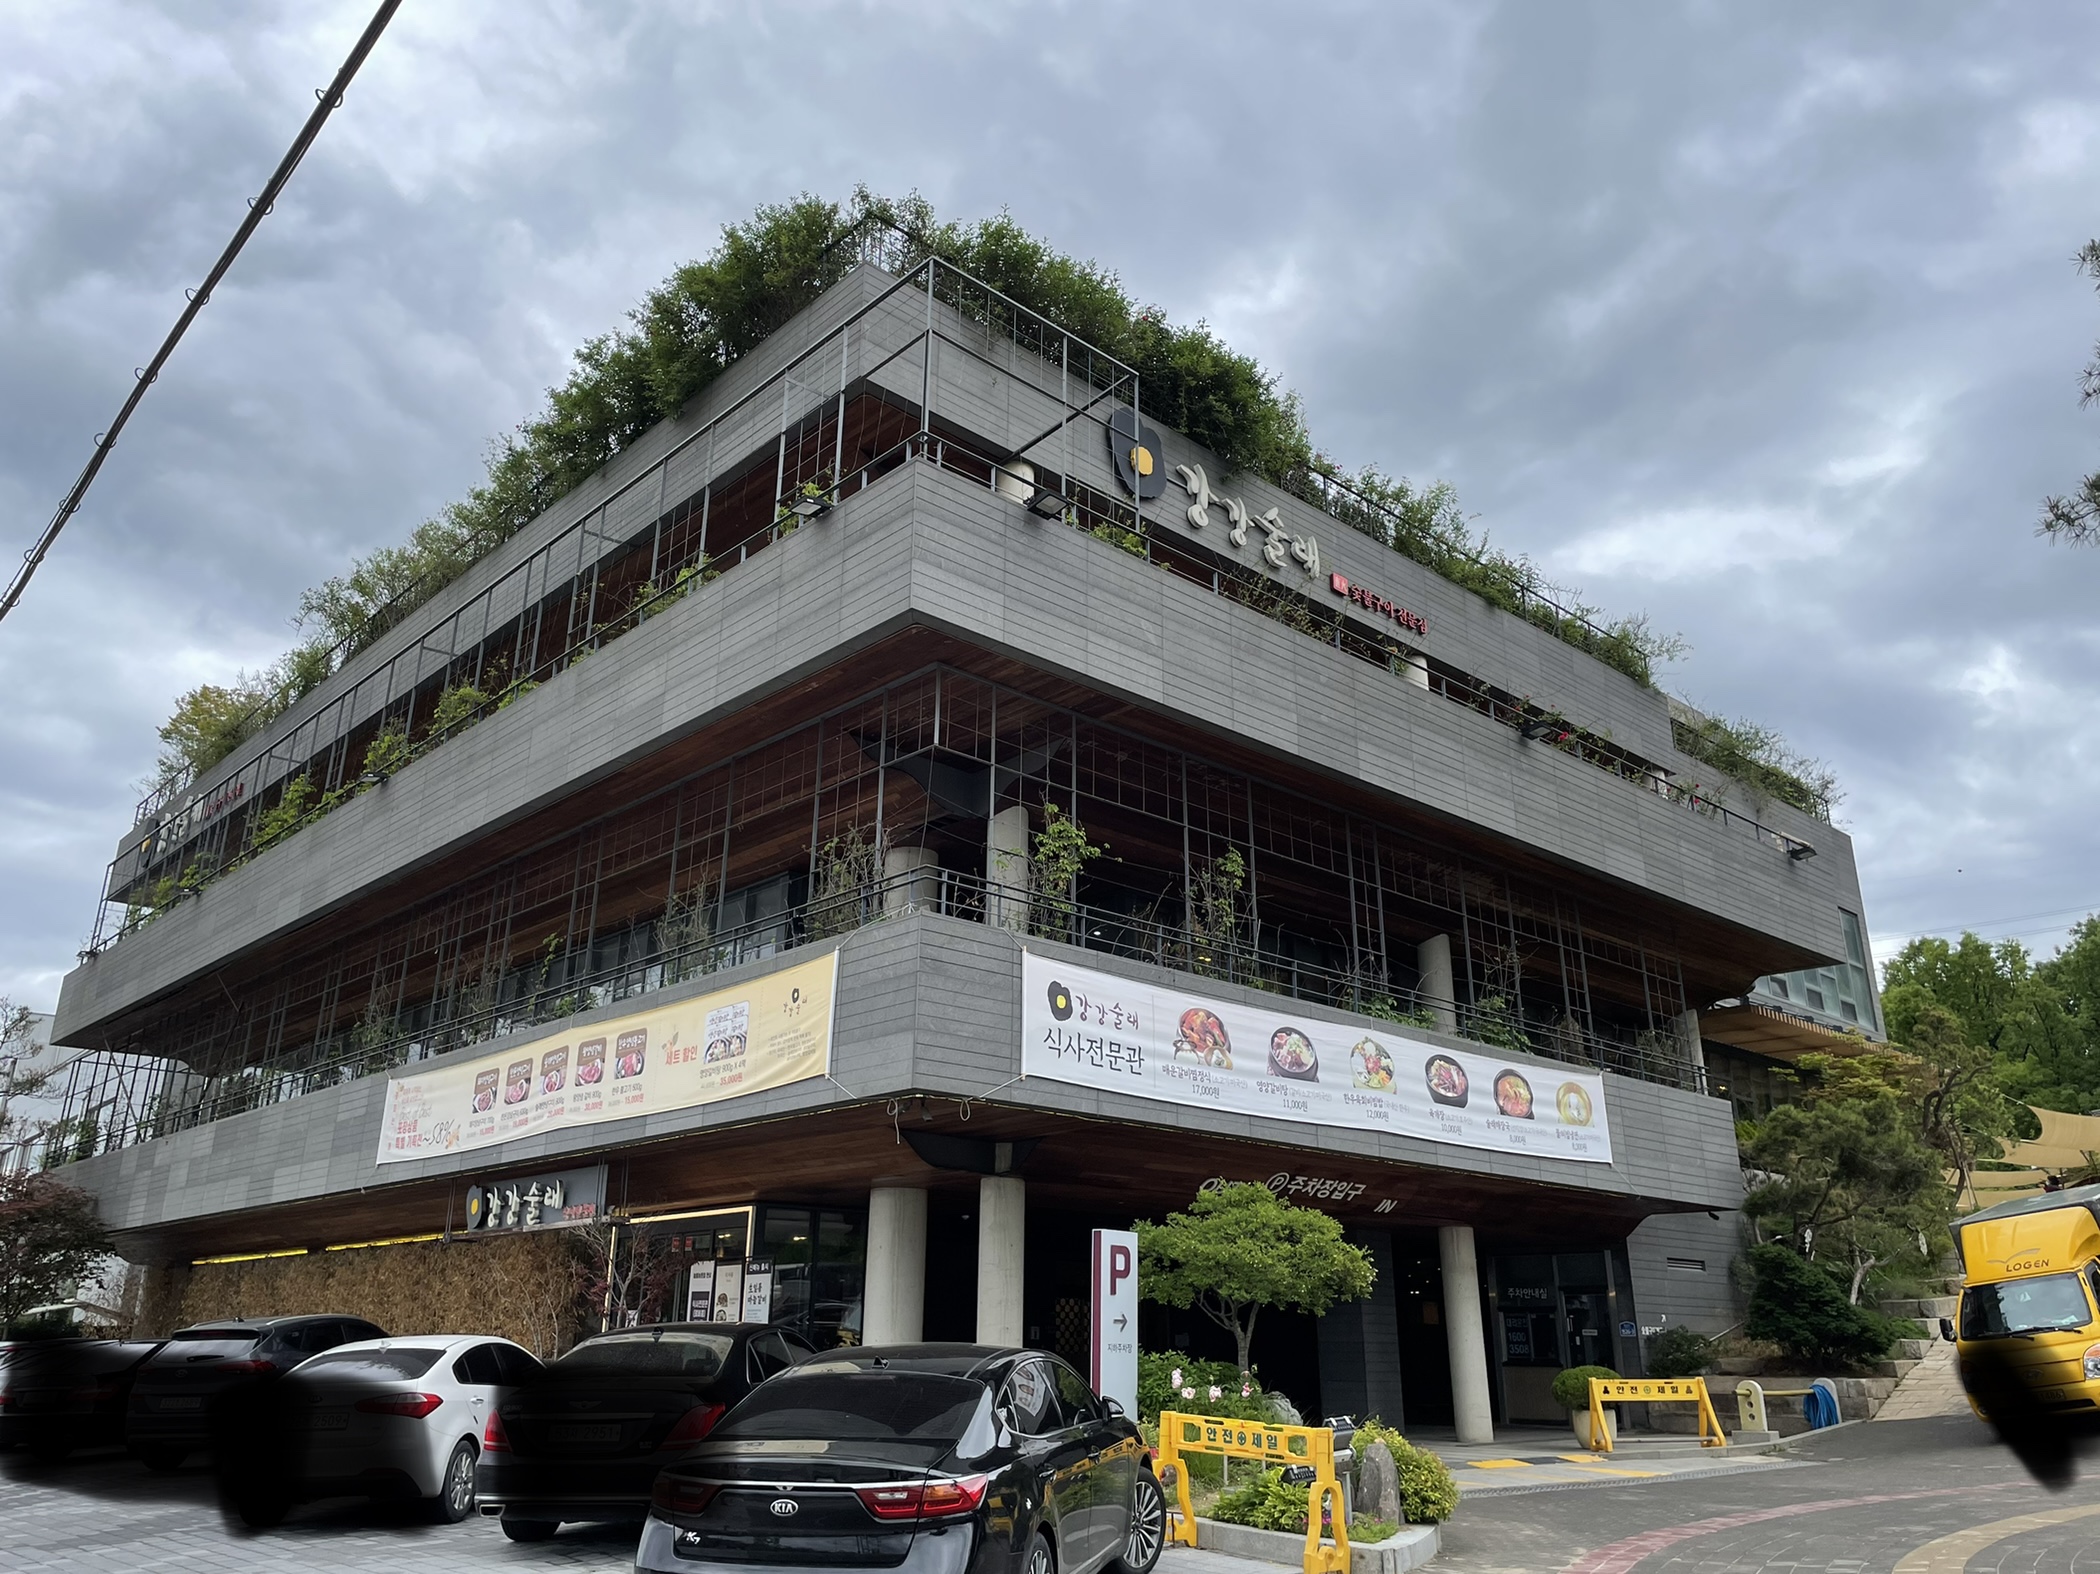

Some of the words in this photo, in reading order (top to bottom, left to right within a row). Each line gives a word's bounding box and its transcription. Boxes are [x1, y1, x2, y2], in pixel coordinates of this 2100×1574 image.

[1176, 464, 1322, 579] 강강술래
[1350, 583, 1395, 619] 숯불구이
[1397, 607, 1429, 635] 전문점
[1076, 993, 1140, 1031] 강강술래
[665, 1049, 681, 1066] 세트
[682, 1045, 698, 1063] 할인
[1043, 1027, 1145, 1076] 식사전문관
[719, 1073, 743, 1087] 35,000원
[1162, 1064, 1211, 1084] 매운갈비찜정식
[1192, 1084, 1220, 1099] 17,000원
[1256, 1080, 1288, 1097] 영양갈비탕
[1282, 1099, 1308, 1112] 11,000원
[1366, 1109, 1389, 1122] 12,000원
[1440, 1123, 1462, 1136] 10,000원
[1287, 1175, 1368, 1201] 주차장입구
[487, 1179, 566, 1228] 강강술래
[1373, 1199, 1399, 1214] IN
[1109, 1244, 1132, 1296] P
[2006, 1258, 2050, 1273] LOGEN
[1507, 1287, 1548, 1300] 주차안내실
[1508, 1331, 1527, 1342] 1600
[1107, 1343, 1133, 1354] 지하주차장
[1509, 1344, 1530, 1354] 3508
[1616, 1385, 1639, 1395] 안전
[1657, 1385, 1680, 1395] 제일
[1206, 1427, 1234, 1445] 안전
[1251, 1432, 1279, 1451] 제일
[686, 1531, 701, 1545] K7
